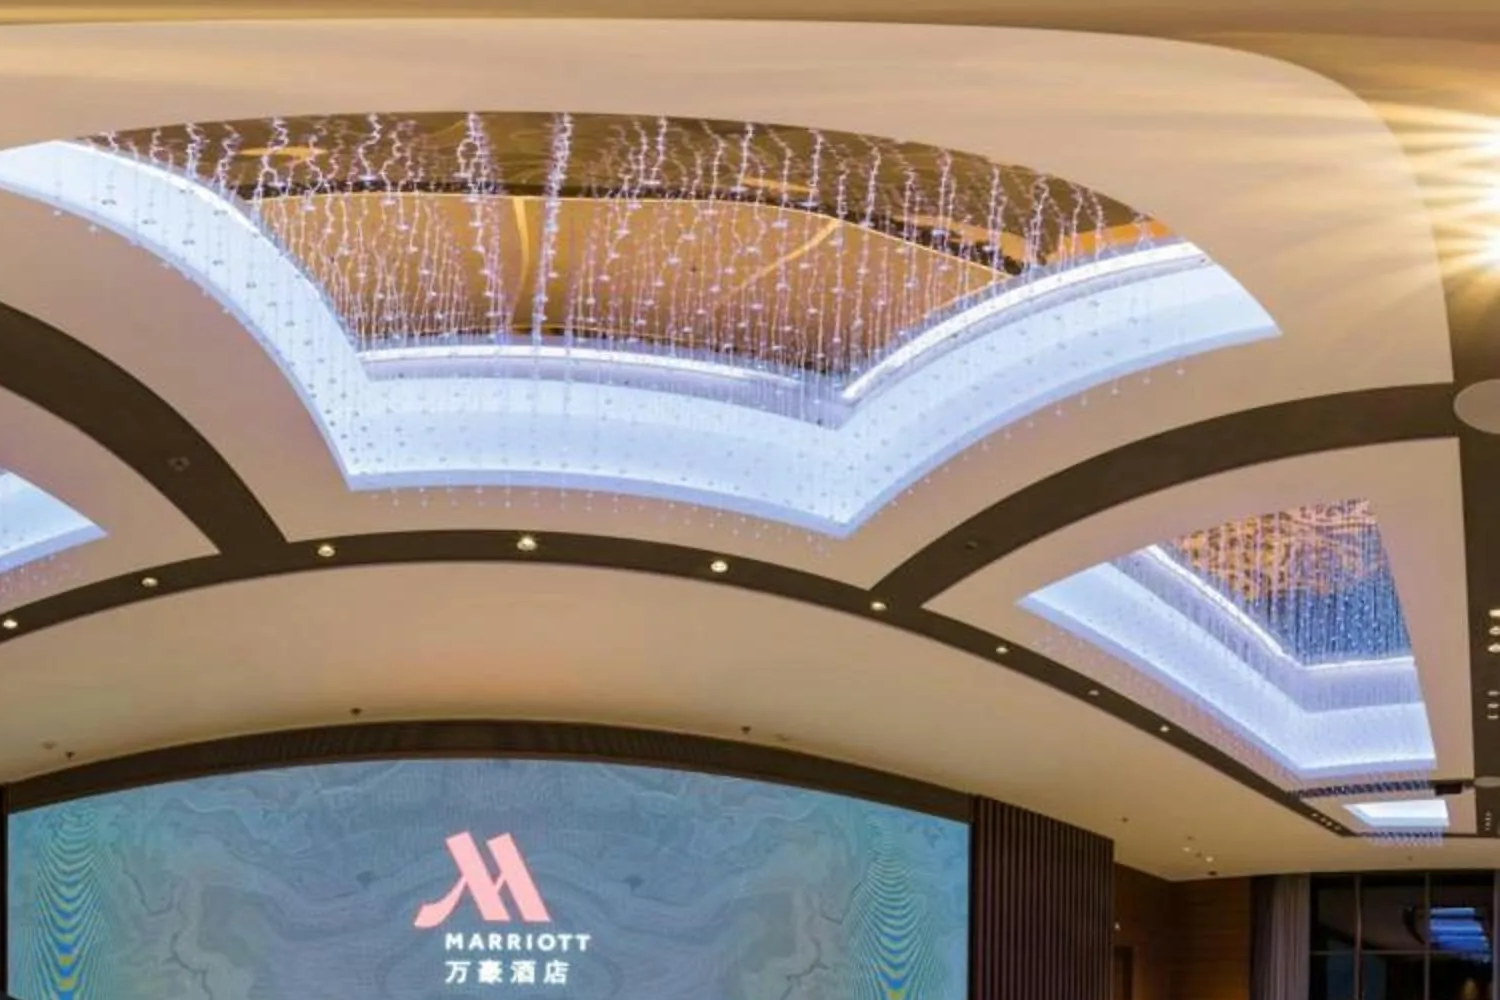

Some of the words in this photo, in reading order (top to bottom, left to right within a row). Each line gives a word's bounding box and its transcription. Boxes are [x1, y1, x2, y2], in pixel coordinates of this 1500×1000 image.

[445, 933, 591, 951] MARRIOTT
[444, 960, 570, 985] 万豪酒店
